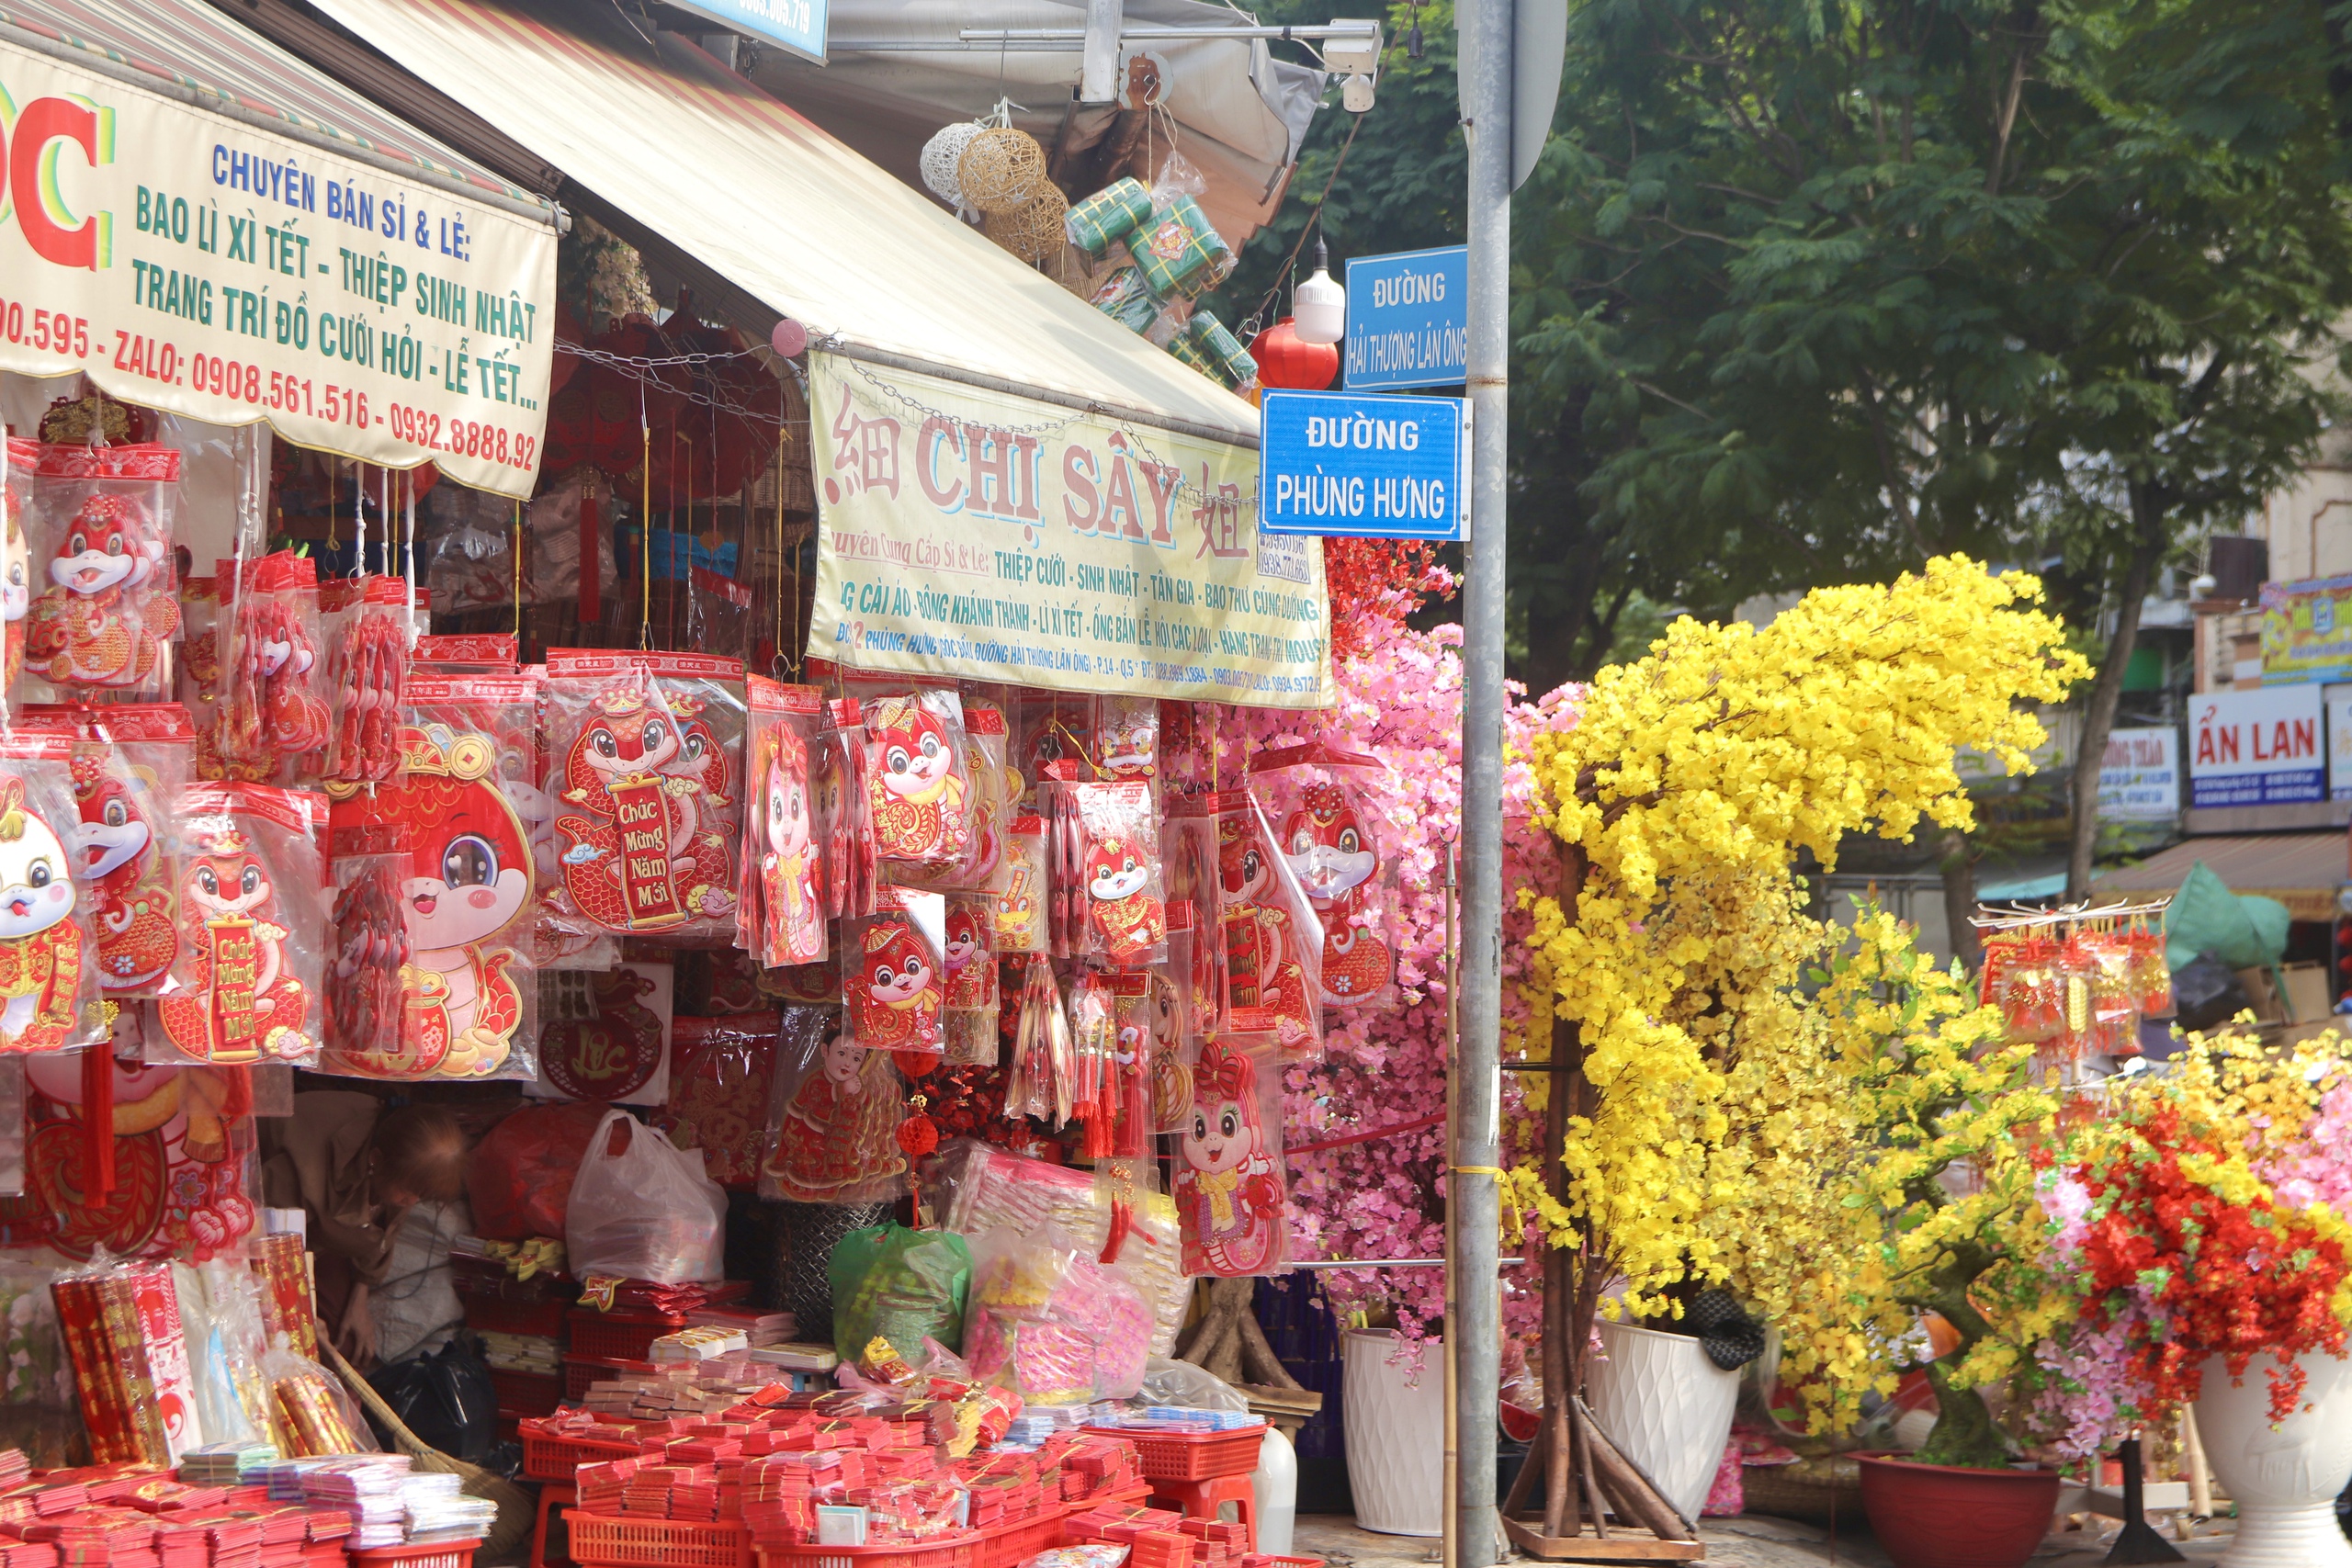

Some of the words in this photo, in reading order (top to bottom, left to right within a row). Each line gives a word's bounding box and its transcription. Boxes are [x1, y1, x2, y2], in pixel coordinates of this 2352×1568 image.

[212, 144, 316, 213] CHUYÊN
[327, 178, 374, 232] BÁN
[381, 191, 406, 242] SỈ
[414, 209, 432, 251] &
[441, 213, 471, 263] LẺ:
[137, 185, 189, 244] BAO
[198, 197, 218, 254] LÌ
[228, 208, 256, 263] XÌ
[266, 217, 311, 279] TẾT
[339, 248, 408, 315] THIỆP
[415, 272, 467, 328] SINH
[476, 289, 537, 354] NHẬT
[1373, 269, 1446, 309] ĐƯỜNG
[132, 258, 213, 327] TRANG
[222, 273, 268, 341] TRÍ
[276, 289, 310, 351] ĐỒ
[319, 309, 374, 366] CƯỚI
[382, 322, 423, 382] HỎI
[445, 334, 469, 397] LỄ
[476, 348, 538, 411] TẾT...
[1348, 323, 1367, 375] HẢI
[1370, 330, 1415, 379] THƯỢNG
[1418, 322, 1441, 369] LÃN
[1443, 320, 1467, 367] ÔNG
[113, 330, 185, 387] ZALO:
[192, 352, 369, 431] 0908.561.516
[390, 402, 537, 473] 0932.8888.92
[1306, 412, 1419, 451] ĐƯỜNG
[915, 415, 1046, 549] CHỊ
[1063, 430, 1185, 549] SÂY
[1192, 461, 1250, 560] 姐
[1276, 465, 1365, 517] PHÙNG
[1374, 475, 1445, 520] HƯNG
[916, 533, 941, 573] Cấp
[944, 539, 956, 568] Sỉ
[958, 544, 968, 570] &
[994, 547, 1034, 587] THIỆP
[1036, 552, 1066, 587] CƯỚI
[1077, 563, 1104, 593] SINH
[1109, 564, 1140, 602] NHẬT
[1150, 569, 1173, 604] TÂN
[1176, 578, 1195, 606] GIA
[1205, 582, 1226, 610] BAO
[1228, 584, 1251, 614] THƯ
[1252, 585, 1281, 617] CÚNG
[1282, 591, 1320, 622] DƯỜNG
[859, 577, 890, 615] CÀI
[892, 579, 911, 617] ÁO
[917, 583, 949, 623] BÔNG
[950, 590, 992, 628] KHÁNH
[995, 594, 1030, 632] THÀNH
[1039, 600, 1049, 635] LÌ
[1051, 600, 1062, 637] XÌ
[1063, 600, 1083, 638] TẾT
[1092, 603, 1114, 642] ỐNG
[1115, 605, 1136, 645] BẮN
[1138, 607, 1152, 648] LỄ
[1155, 615, 1171, 654] HỘI
[1171, 617, 1192, 651] CÁC
[1193, 626, 1213, 660] LOẠI
[1219, 624, 1249, 657] HÀNG
[865, 626, 906, 652] PHÙNG
[907, 632, 938, 656] HƯNG
[975, 638, 1008, 663] ĐƯỜNG
[1010, 639, 1025, 665] HẢI
[1026, 646, 1054, 671] THƯỢNG
[1056, 647, 1071, 671] LÃN
[1097, 656, 1114, 675] P.14
[1120, 659, 1134, 679] Q.5
[1141, 660, 1154, 679] ĐT:
[2253, 717, 2314, 761] LAN
[618, 798, 658, 824] Chúc
[625, 826, 666, 852] Mừng
[631, 855, 667, 879] Năm
[638, 884, 669, 908] Mới
[220, 936, 255, 962] Chúc
[220, 964, 255, 989] Mừng
[219, 988, 255, 1014] Năm
[225, 1014, 255, 1040] Mới
